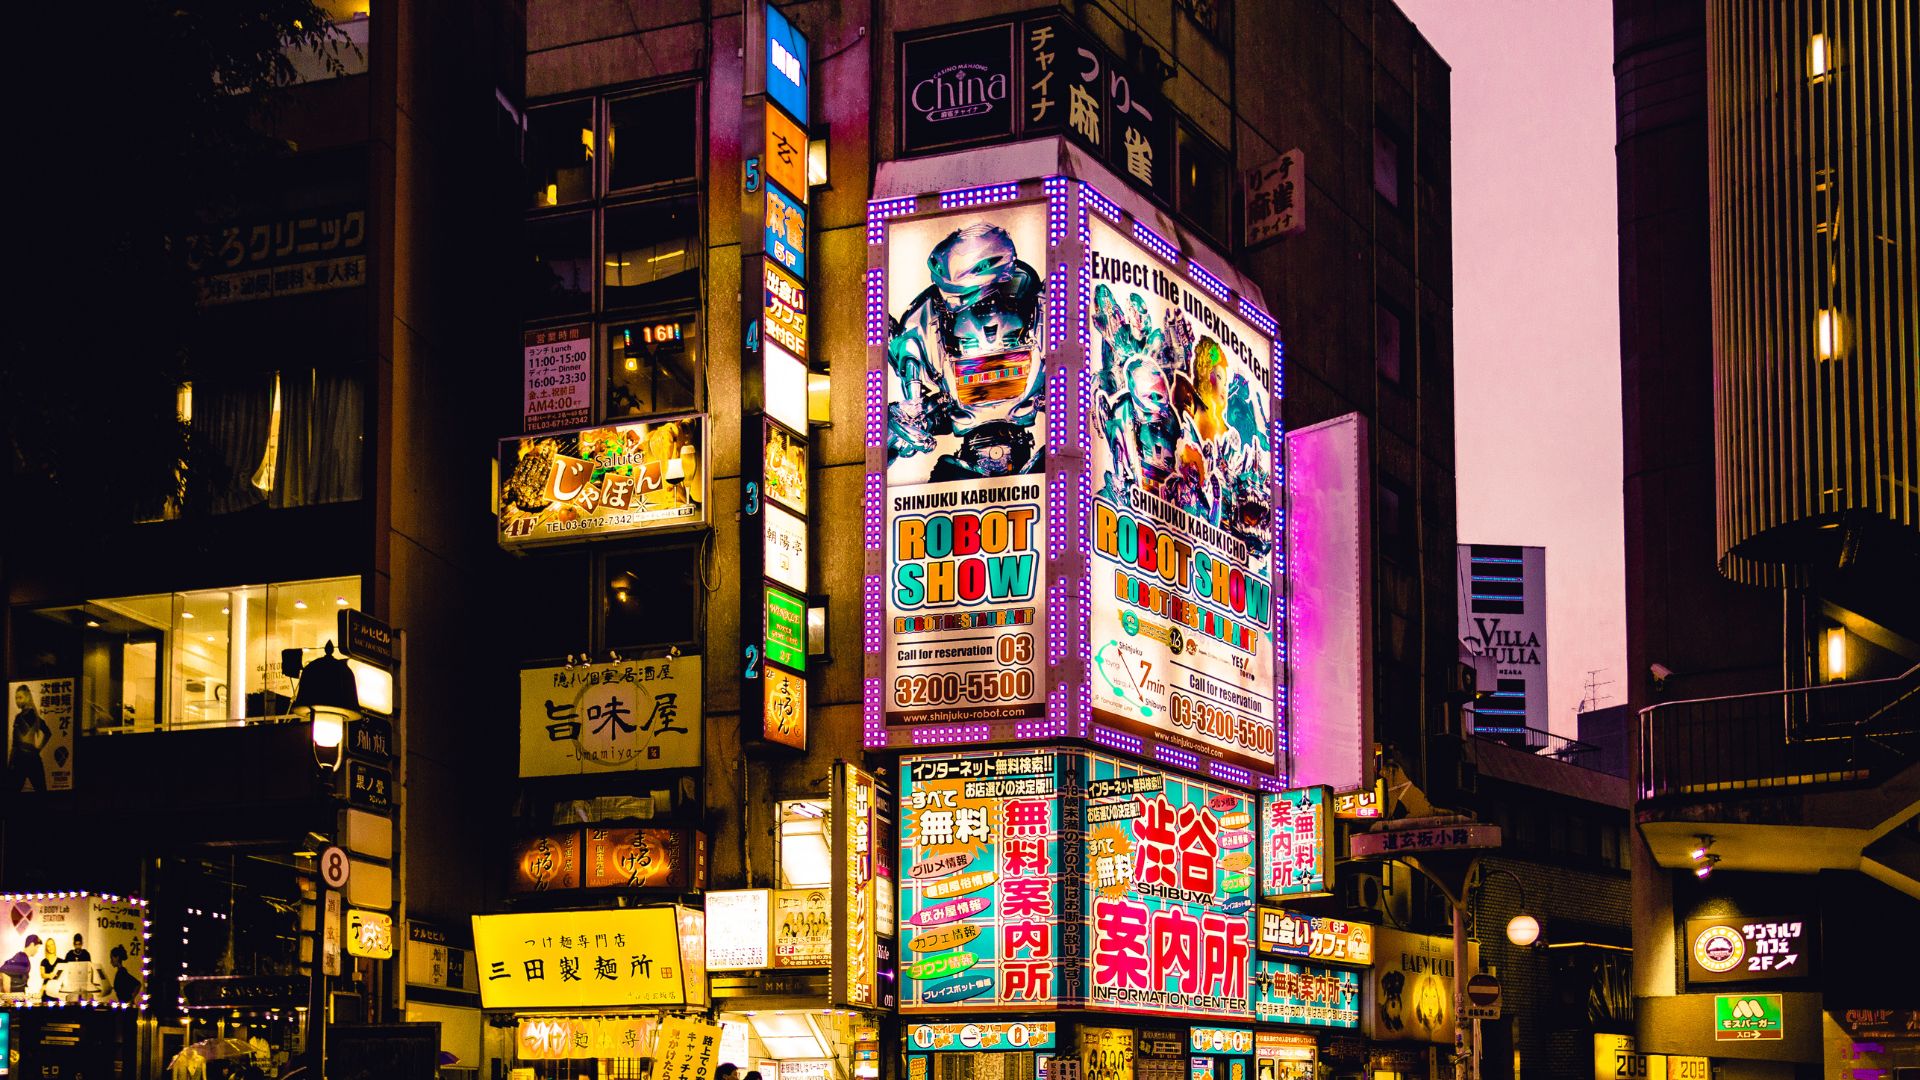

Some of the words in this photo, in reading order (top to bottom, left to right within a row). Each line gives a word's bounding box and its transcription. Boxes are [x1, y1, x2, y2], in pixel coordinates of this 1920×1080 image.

[1031, 26, 1055, 121] チャイナ
[911, 71, 1006, 112] China
[1069, 84, 1153, 187] 麻雀
[746, 159, 760, 193] 5
[774, 240, 796, 267] 5F
[766, 269, 804, 309] 出会い
[770, 296, 804, 333] カフェ
[1091, 251, 1149, 289] Expect
[1152, 269, 1180, 306] the
[1182, 288, 1270, 392] unexpected
[746, 319, 760, 352] 4
[528, 352, 587, 368] 11:00-15:00
[529, 348, 549, 356] ランチ
[551, 344, 572, 353] Lunch
[528, 372, 587, 389] 16:00-23:30
[558, 364, 581, 373] Dinner
[528, 397, 572, 413] AM4:00
[595, 451, 643, 470] Salute
[553, 459, 662, 510] じゃぽん
[745, 482, 759, 515] 3
[894, 491, 957, 511] SHINJUKU
[961, 484, 1040, 506] KABUKICHO
[504, 517, 539, 537] 4F
[546, 514, 632, 532] TEL03-6712-7342
[898, 508, 1034, 562] ROBOT
[1132, 487, 1186, 531] SHINJUKU
[1188, 515, 1247, 562] KABUKICHO
[1096, 503, 1193, 589] ROBOT
[1194, 550, 1270, 626] SHOW
[897, 554, 1034, 605] SHOW
[895, 613, 943, 633] ROBOT
[943, 607, 1035, 632] RESTAURANT
[1115, 571, 1170, 617] ROBOT
[1170, 593, 1258, 654] RESTAURANT
[1473, 617, 1541, 647] VILLA
[897, 648, 917, 661] Call
[918, 648, 932, 660] for
[934, 645, 993, 660] reservation
[998, 634, 1033, 664] 03
[1118, 641, 1143, 656] Shinjuku
[745, 645, 758, 678] 2
[553, 664, 674, 688] 隠れ個室居酒屋
[896, 669, 1033, 705] 3200-5500
[1139, 660, 1152, 688] 7
[1147, 678, 1165, 696] min
[1145, 698, 1167, 712] Shibuya
[1190, 674, 1207, 692] Call
[1207, 681, 1218, 695] for
[1219, 686, 1262, 714] reservation
[59, 716, 70, 730] 2F
[544, 693, 689, 742] 旨味屋
[903, 707, 1025, 723] www.shinjuku-robot.com
[1171, 694, 1274, 755] 03-3200-5500
[1154, 731, 1224, 758] www.shinjuku-robot.com
[912, 756, 1053, 779] インターネット無料検索!!
[965, 778, 1053, 798] お店選びの決定版!!
[1088, 775, 1163, 797] インターネット無料検索!!
[911, 790, 958, 809] すべて
[1087, 802, 1141, 823] お店選びの決定版!!
[592, 829, 609, 842] 2F
[919, 806, 991, 846] 無料
[1088, 838, 1115, 856] すべて
[1133, 793, 1219, 895] 渋谷
[1271, 800, 1293, 888] 案内所
[1295, 815, 1314, 870] 無料
[1383, 828, 1468, 850] 道玄坂小路
[328, 853, 342, 881] 8
[621, 829, 652, 888] まるげん
[912, 854, 968, 876] グルメ情報
[1095, 853, 1135, 888] 無料
[1002, 799, 1051, 1001] 無料案内所
[1138, 883, 1214, 906] SHIBUYA
[919, 897, 983, 924] 飲み屋情報
[525, 933, 626, 949] つけ麺専門店
[914, 925, 977, 949] カフェ情報
[1262, 912, 1309, 946] 出会い
[1742, 922, 1802, 940] サンマルク
[130, 942, 141, 956] 2F
[876, 944, 889, 960] Ride
[1095, 900, 1249, 1000] 案内所
[1309, 931, 1346, 958] カフェ
[1755, 938, 1790, 955] カフェ
[488, 953, 653, 982] 三田製麺所
[911, 953, 973, 978] タウン情報
[1748, 956, 1775, 971] 2F
[856, 984, 869, 1001] 6F
[923, 979, 992, 1000] プレイスポット情報
[1093, 985, 1190, 1004] INFORMATION
[1193, 995, 1247, 1010] CENTER
[1273, 971, 1341, 1005] 無料案内所
[933, 1024, 955, 1033] トイレ
[980, 1025, 1002, 1033] タバコ
[1028, 1023, 1048, 1032] 充電
[1722, 1019, 1776, 1029] モスバーガー
[1737, 1031, 1751, 1039] 入口
[696, 1035, 714, 1080] 路上での
[1616, 1054, 1647, 1077] 209
[1681, 1060, 1706, 1079] 209
